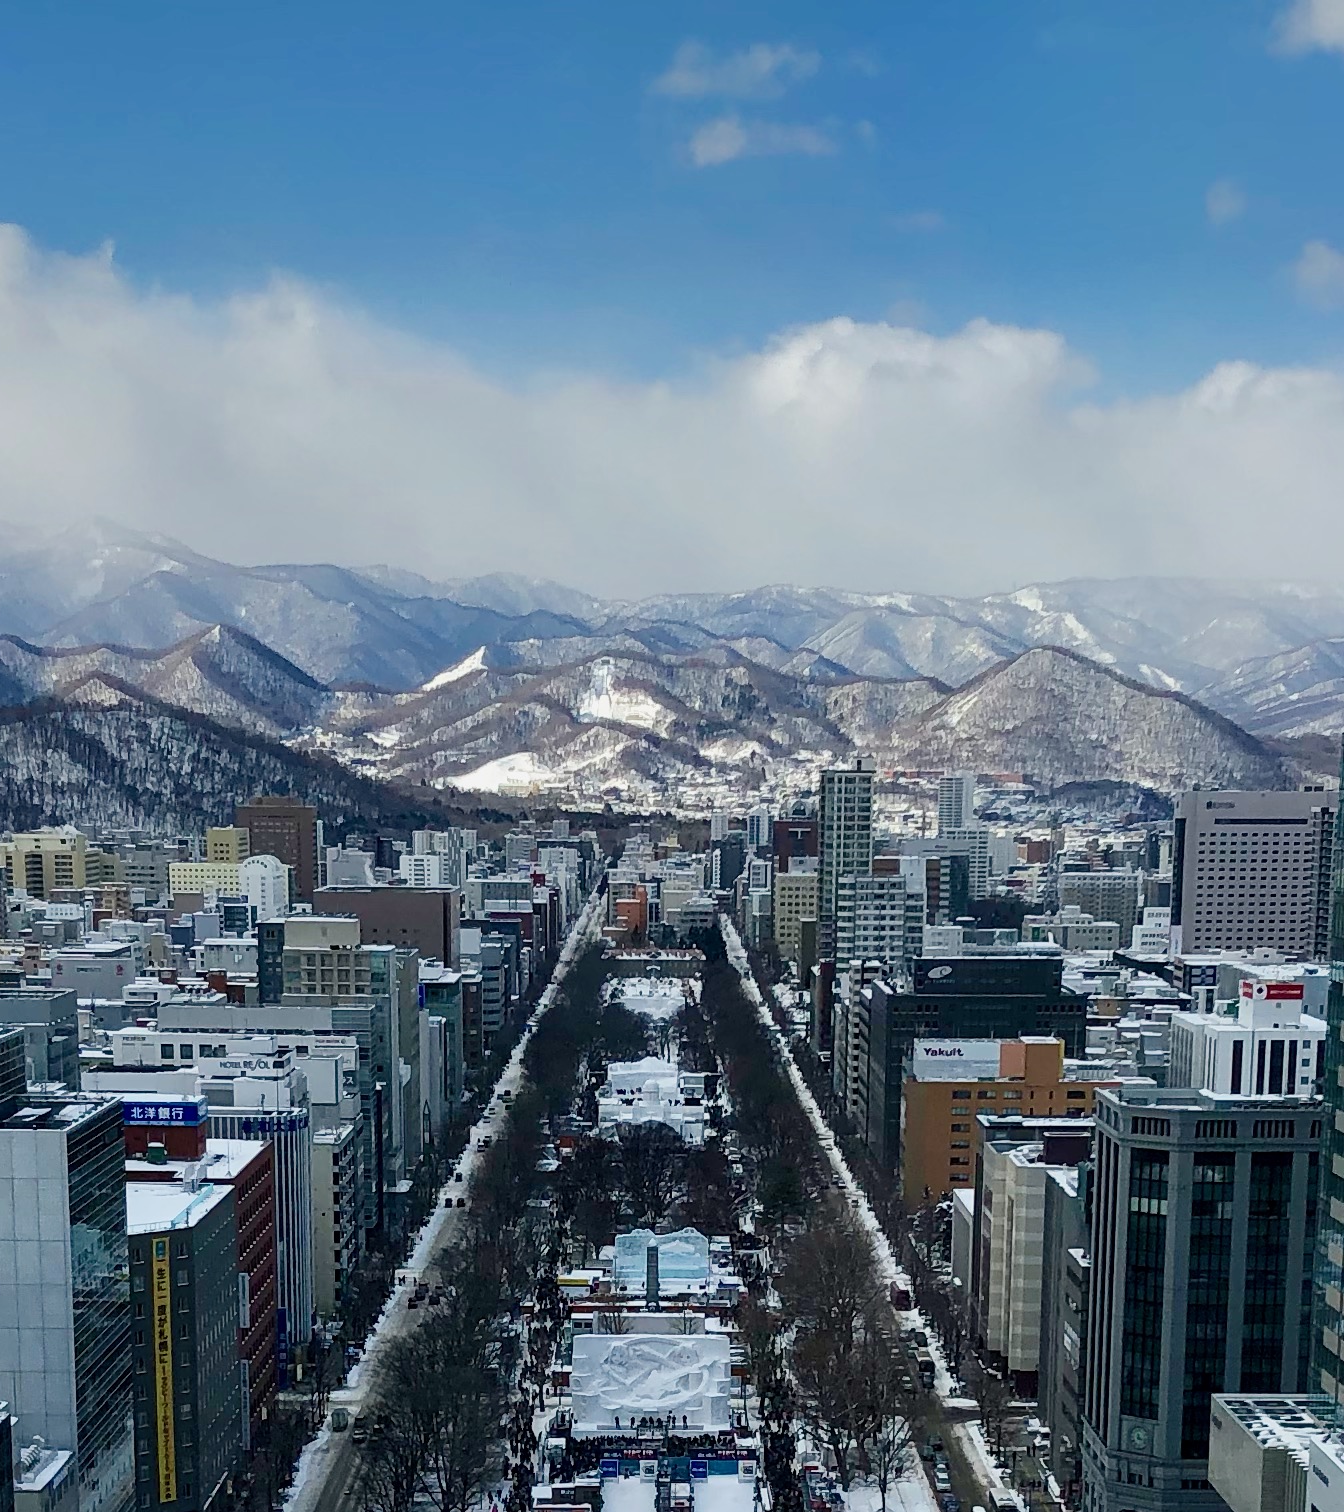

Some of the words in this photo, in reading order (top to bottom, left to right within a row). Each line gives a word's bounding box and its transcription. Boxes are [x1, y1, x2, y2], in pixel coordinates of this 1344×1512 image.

[923, 1047, 964, 1057] Yakult
[130, 1106, 184, 1120] 北洋銀行
